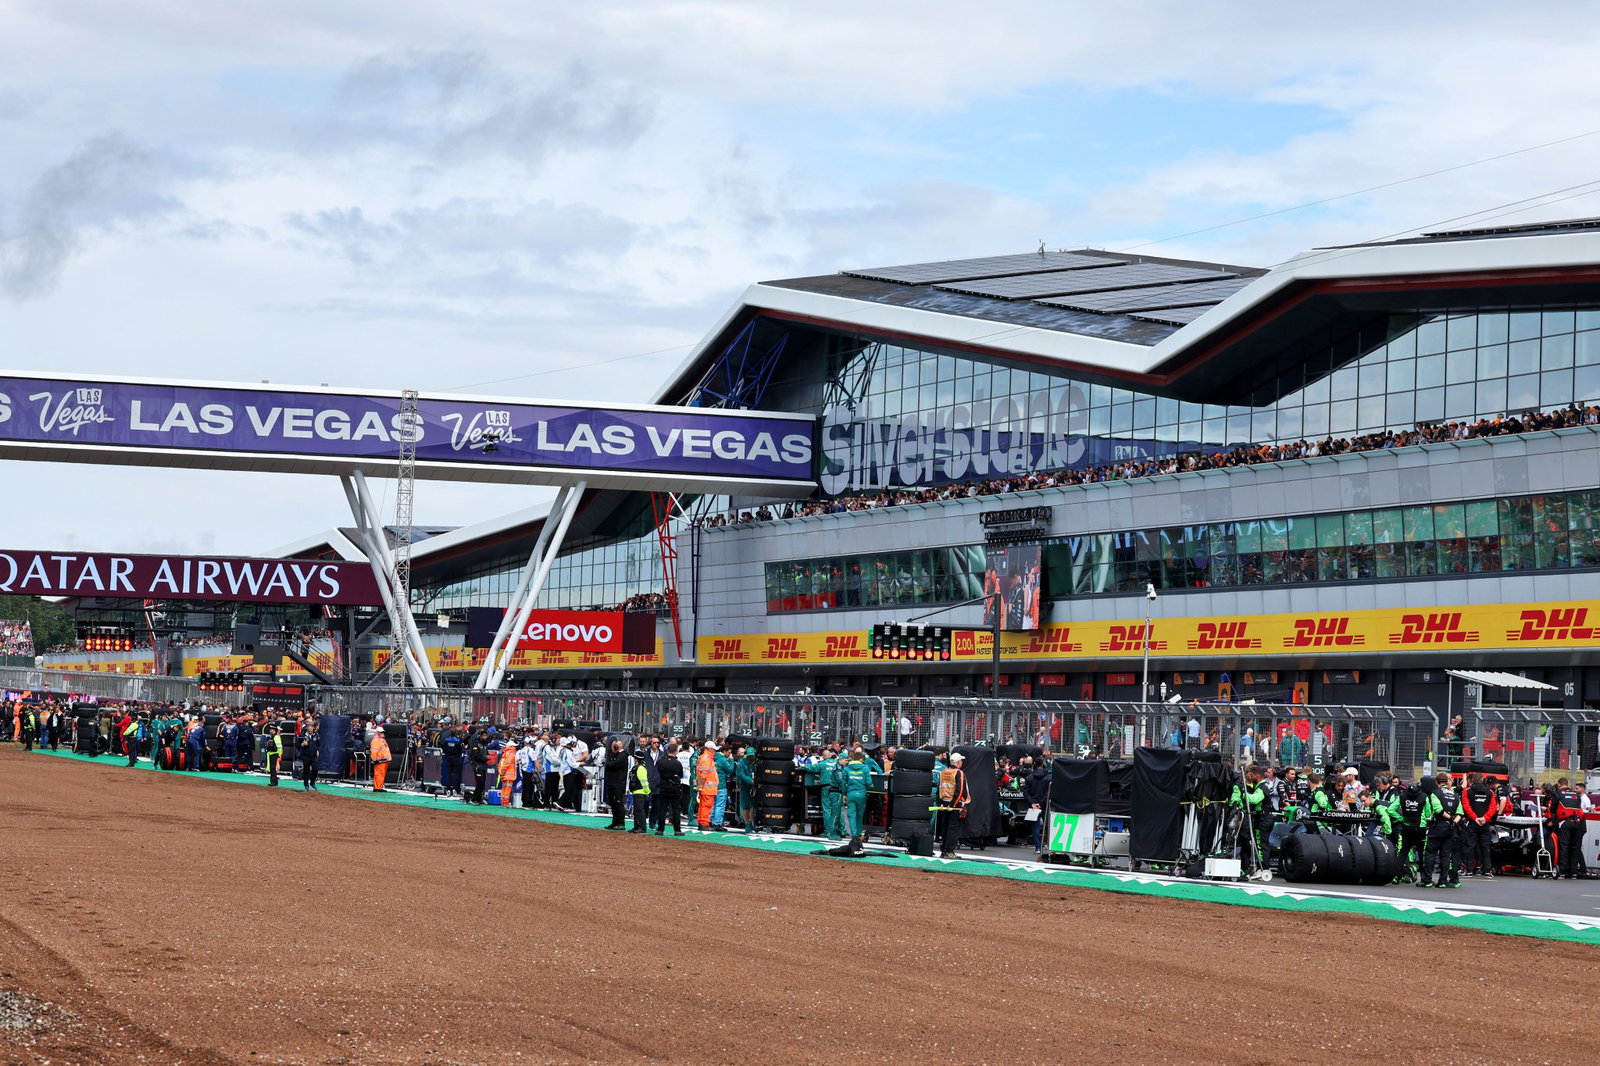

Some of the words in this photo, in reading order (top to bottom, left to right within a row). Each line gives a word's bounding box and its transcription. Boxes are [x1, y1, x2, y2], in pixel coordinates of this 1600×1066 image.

[77, 389, 102, 404] LAS
[29, 390, 115, 436] Vegas
[130, 400, 234, 435] LAS
[245, 406, 425, 443] VEGAS
[487, 411, 509, 426] LAS
[537, 421, 635, 455] LAS
[645, 427, 812, 464] VEGAS
[822, 385, 1089, 495] Silverstone
[149, 560, 340, 599] AIRWAYS
[519, 622, 612, 643] enovo
[1197, 622, 1251, 649] DHL
[1294, 617, 1353, 647] DHL
[1400, 612, 1467, 643] DHL
[1519, 608, 1594, 641] DHL
[714, 640, 743, 660] DHL
[767, 638, 800, 659] DHL
[825, 635, 861, 657] DHL
[1028, 628, 1073, 653] DHL
[1109, 625, 1158, 651] DHL
[1378, 683, 1386, 696] 07
[1564, 682, 1574, 696] 05
[810, 731, 822, 739] 22
[862, 734, 868, 742] 6
[1314, 755, 1322, 765] 5
[1050, 814, 1079, 852] 27
